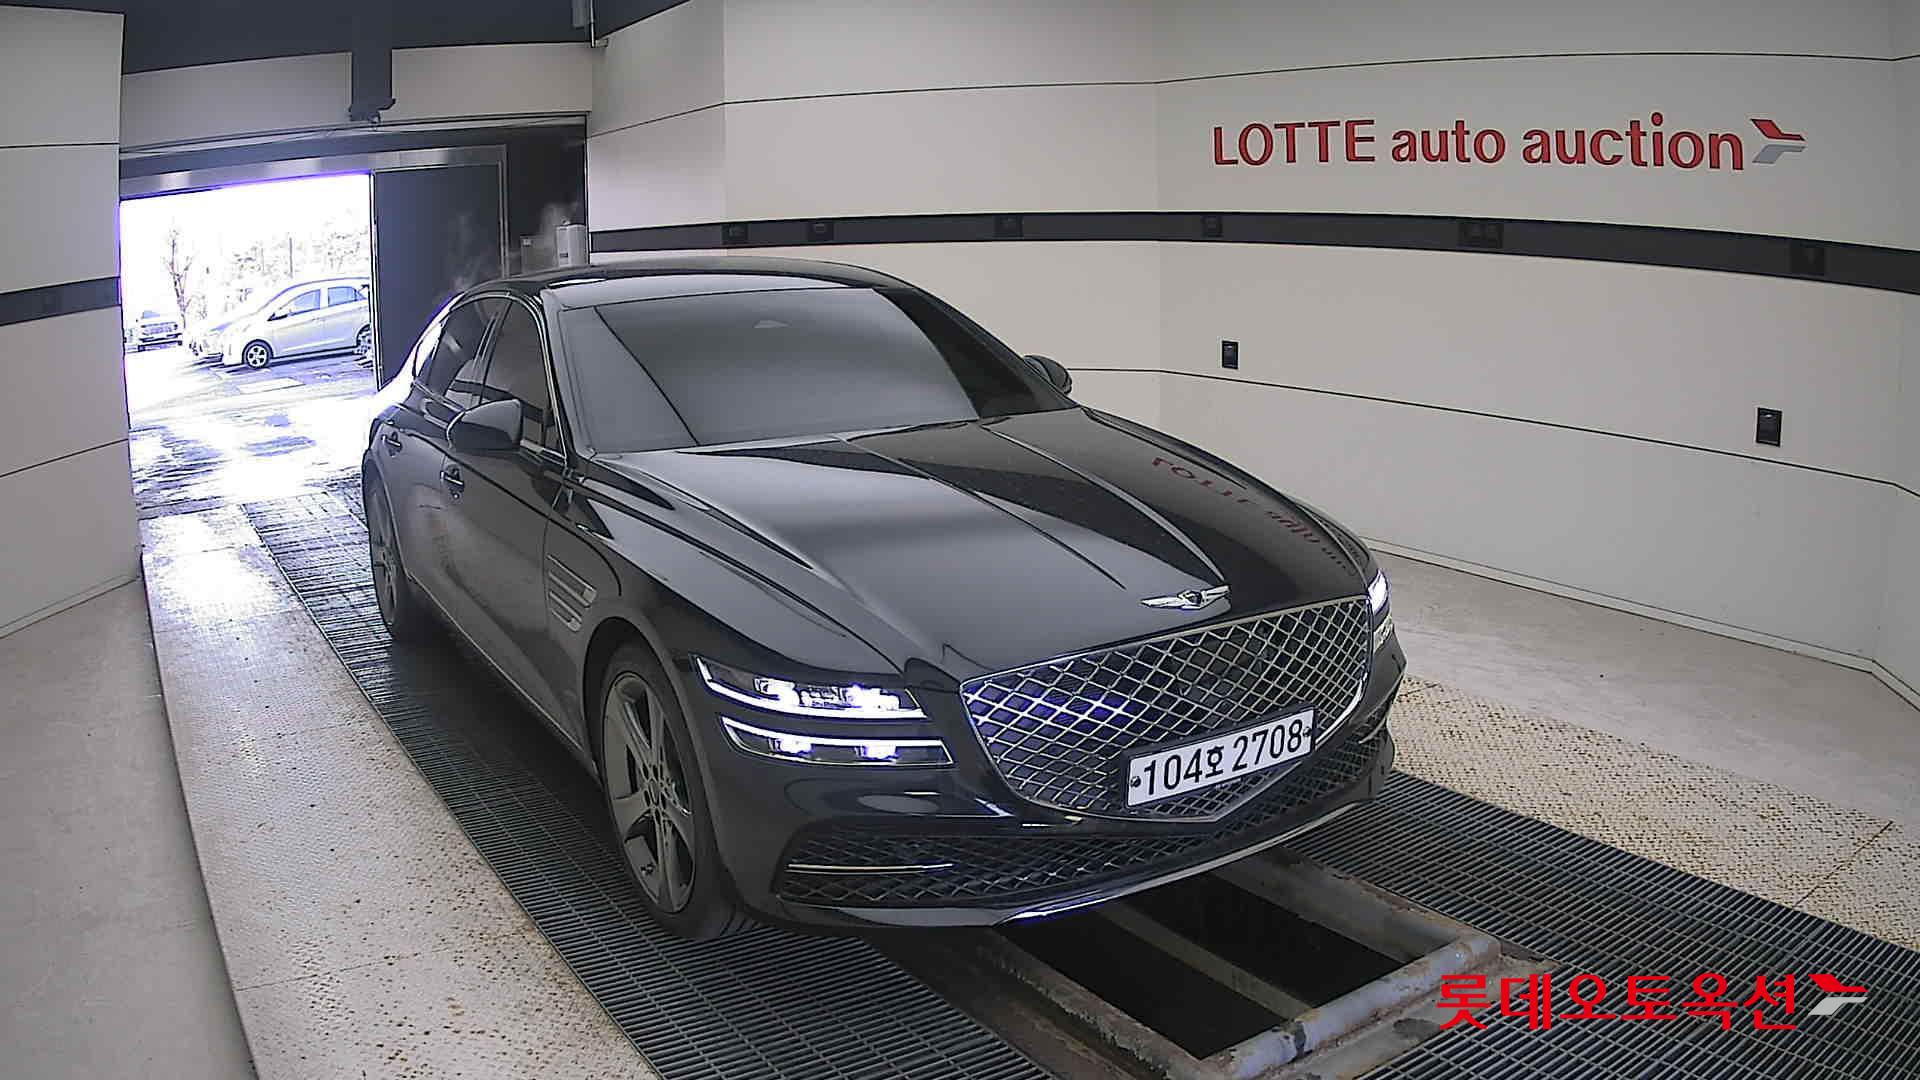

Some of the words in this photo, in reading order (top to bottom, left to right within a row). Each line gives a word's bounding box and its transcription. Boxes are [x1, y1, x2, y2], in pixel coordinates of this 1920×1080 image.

[1213, 119, 1376, 165] LOTTE
[1391, 119, 1506, 164] auto
[1521, 112, 1745, 171] auction
[1144, 746, 1225, 796] 104호
[1231, 719, 1304, 773] 2708
